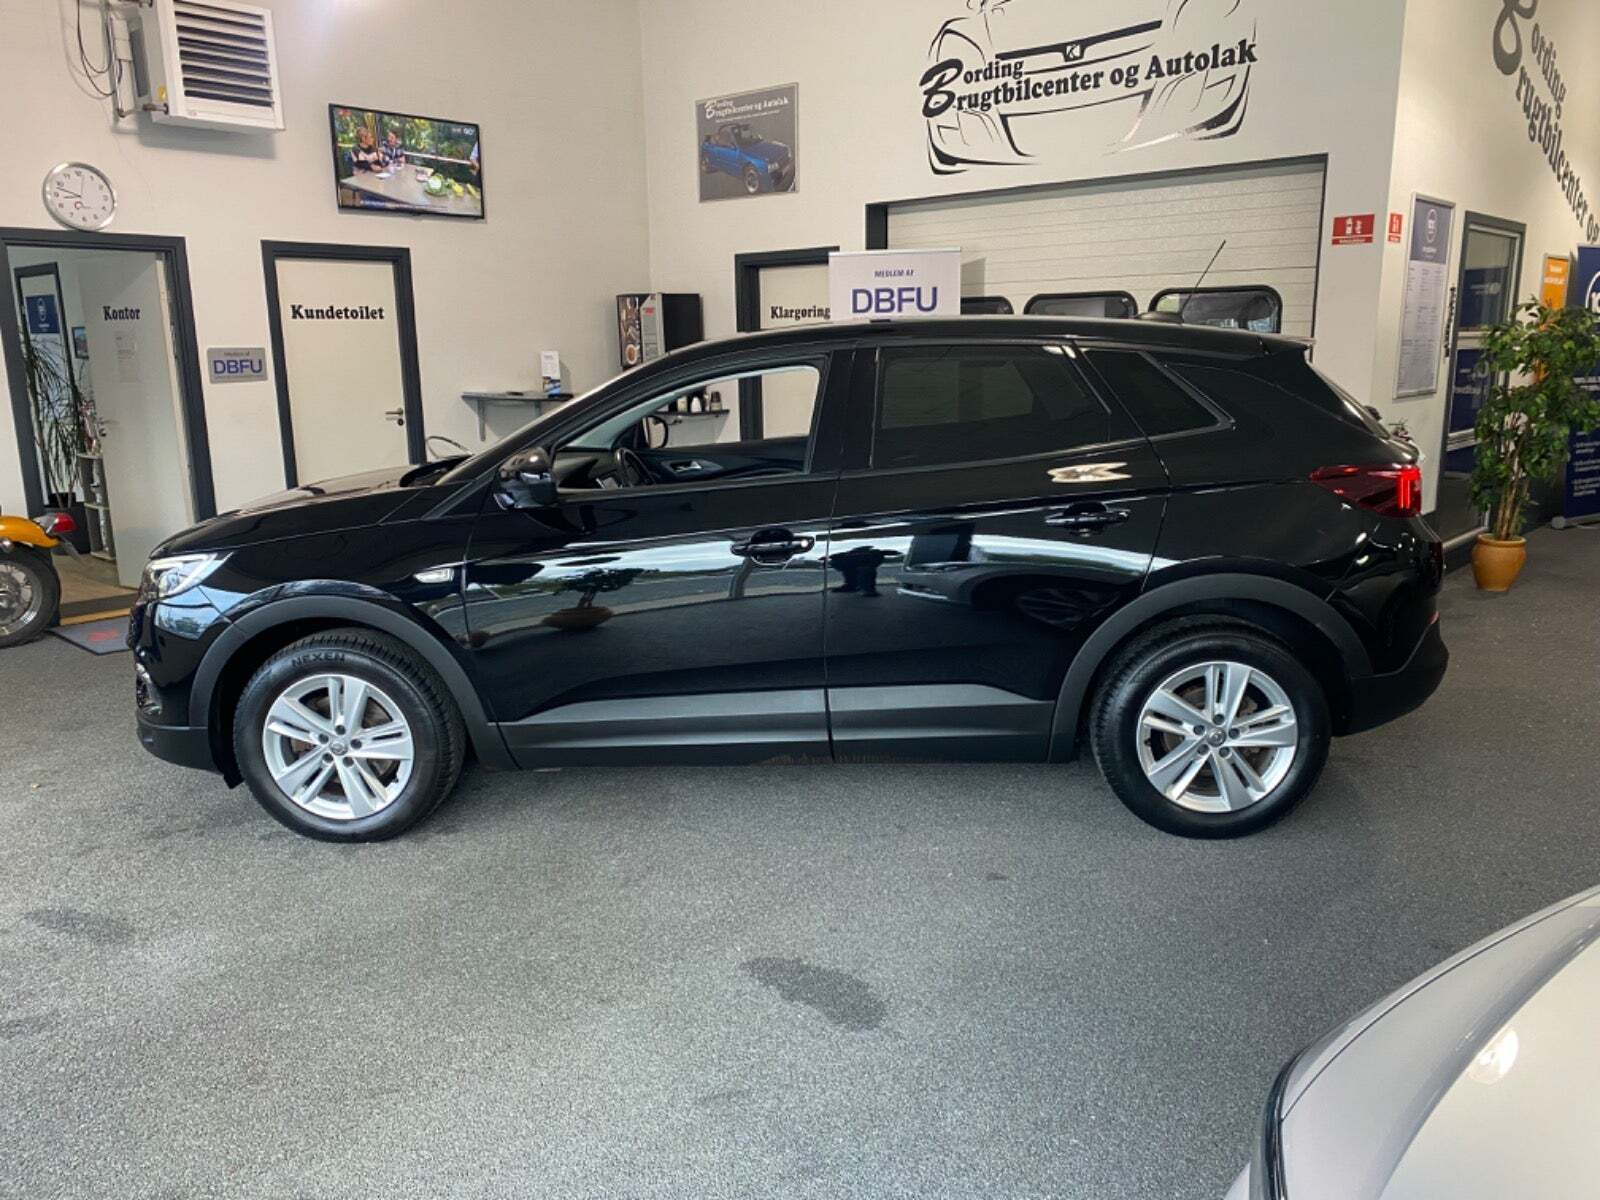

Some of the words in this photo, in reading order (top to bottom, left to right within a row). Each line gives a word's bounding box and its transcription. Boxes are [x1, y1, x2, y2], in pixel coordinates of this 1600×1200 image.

[919, 59, 1104, 118] Brugtbilcenter
[1110, 62, 1140, 88] og
[1145, 38, 1257, 80] Autolak
[919, 58, 1024, 117] Bording
[852, 286, 938, 314] DBFU
[103, 305, 141, 321] Kontor
[290, 304, 385, 320] Kundetoilet
[213, 359, 263, 374] DBFU
[292, 652, 346, 666] NEXEN
